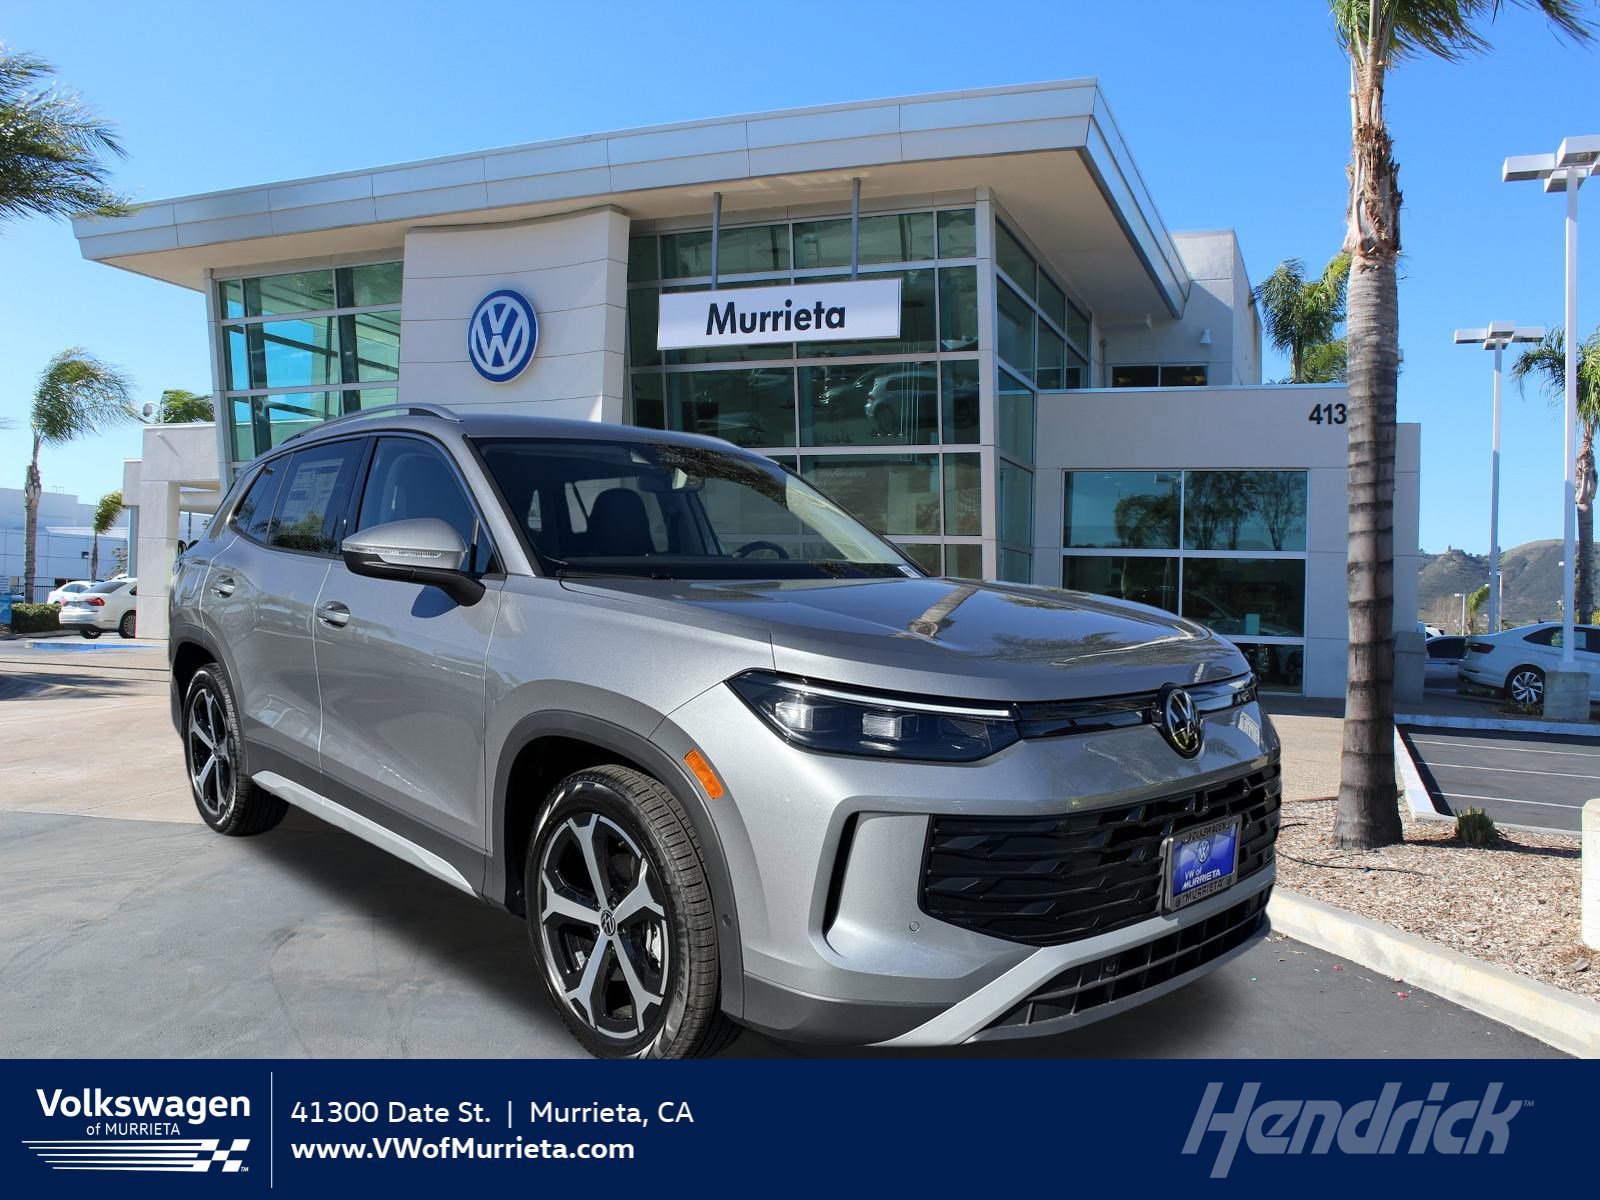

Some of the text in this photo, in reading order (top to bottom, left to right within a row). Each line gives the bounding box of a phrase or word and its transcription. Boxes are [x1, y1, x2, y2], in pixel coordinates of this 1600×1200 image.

[706, 299, 846, 336] Murrieta
[1181, 868, 1221, 891] MURRIETA
[1184, 869, 1195, 880] VW
